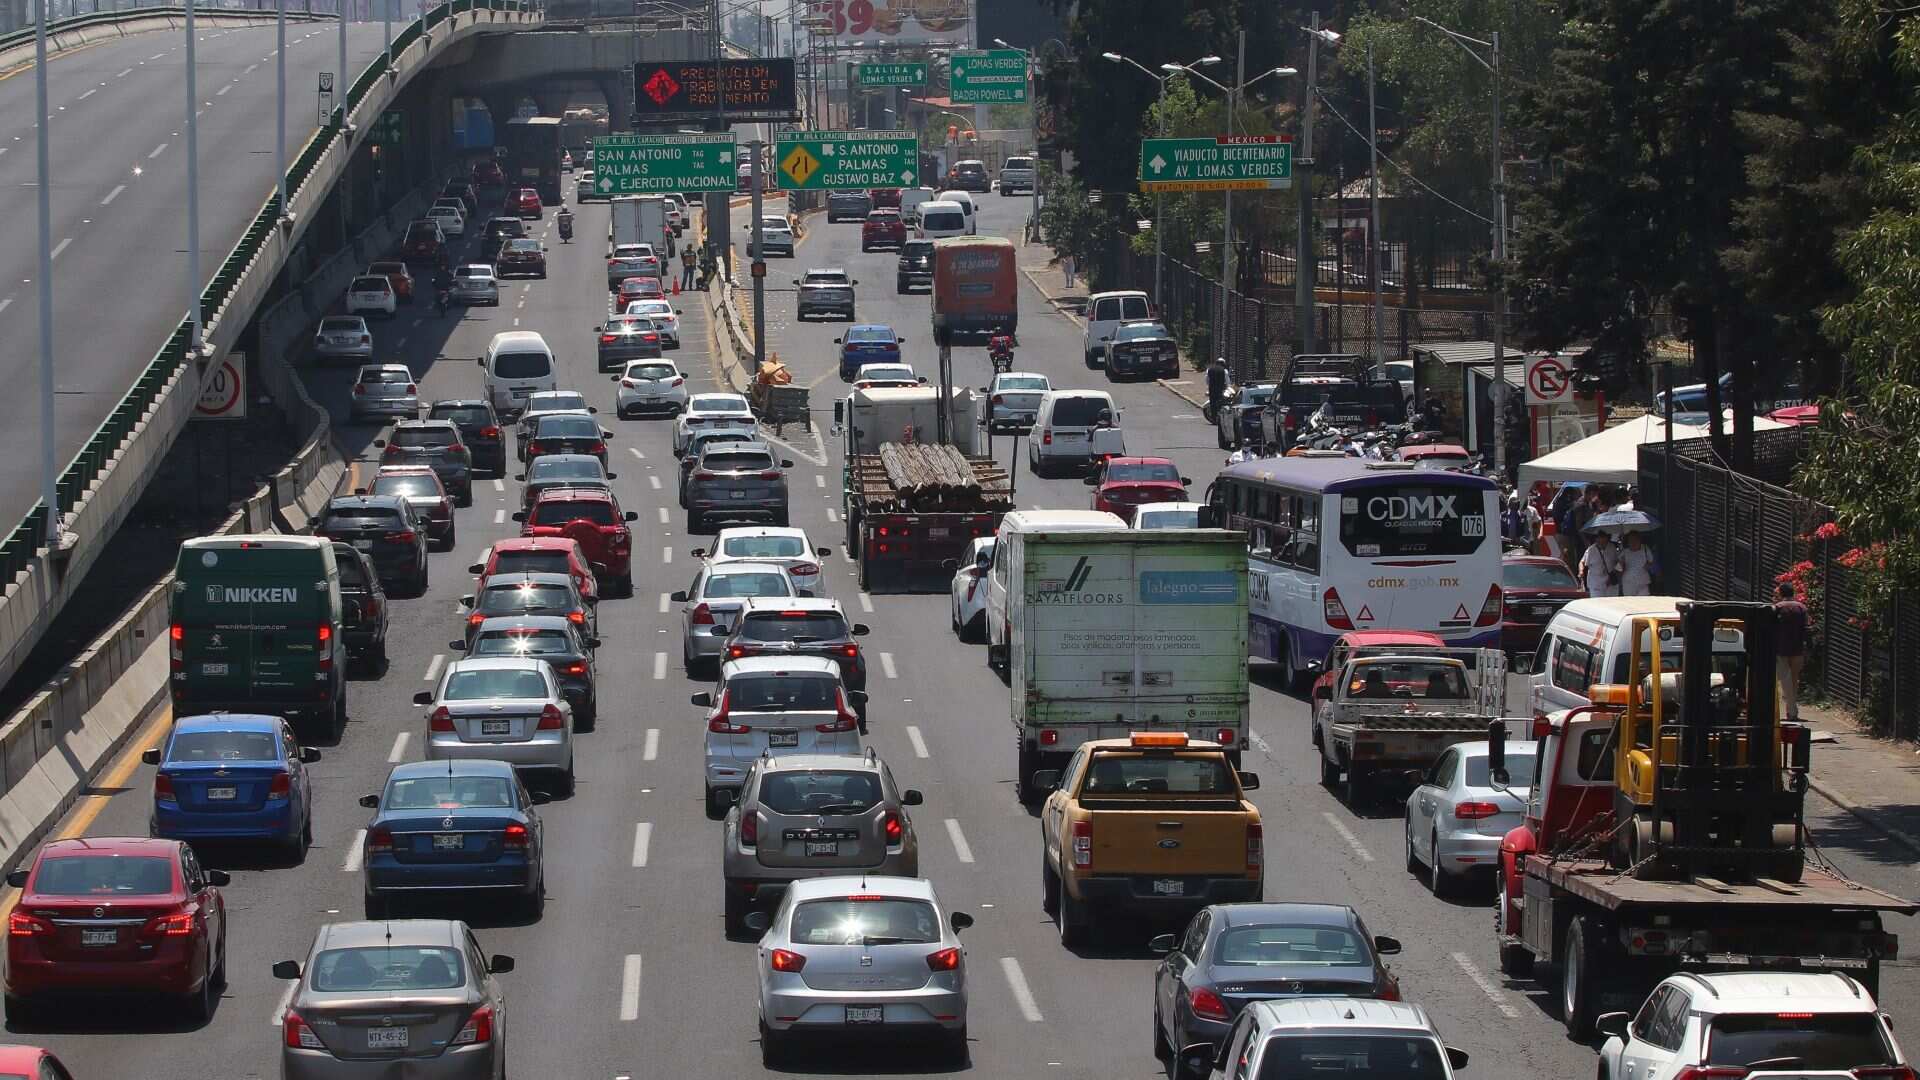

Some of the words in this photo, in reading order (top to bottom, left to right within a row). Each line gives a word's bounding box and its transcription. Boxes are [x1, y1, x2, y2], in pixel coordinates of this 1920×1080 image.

[968, 59, 992, 69] LOMAS
[994, 58, 1023, 68] VERDES
[867, 66, 908, 74] SALIDA
[761, 80, 778, 90] EN
[862, 76, 884, 84] LOMAS
[690, 93, 769, 104] PAVMENTO
[953, 91, 981, 100] BADEN
[982, 90, 1010, 100] POWELL
[1228, 136, 1265, 144] MEXICO
[598, 150, 624, 161] SAN
[630, 148, 682, 160] ANTONIO
[1174, 149, 1217, 161] VIADUCTO
[1223, 147, 1285, 160] BICENTENARIO
[598, 164, 649, 176] PALMAS
[839, 160, 887, 170] PALMAS
[1176, 165, 1190, 177] AV.
[1198, 164, 1234, 176] LOMAS
[1241, 163, 1283, 175] VERDES
[621, 177, 674, 189] EJERCITO
[678, 176, 733, 188] NACIONAL
[824, 174, 869, 185] GUSTAVO
[873, 173, 895, 184] BAZ
[1367, 496, 1458, 521] CDMX
[1465, 518, 1482, 534] 076
[1146, 580, 1198, 596] lalegno
[1249, 572, 1270, 600] CDMX
[225, 588, 297, 602] NIKKEN
[1026, 594, 1124, 604] ZAYATFLOORS
[1064, 633, 1082, 641] Pisos
[1084, 633, 1095, 641] de
[1061, 642, 1082, 650] pisos
